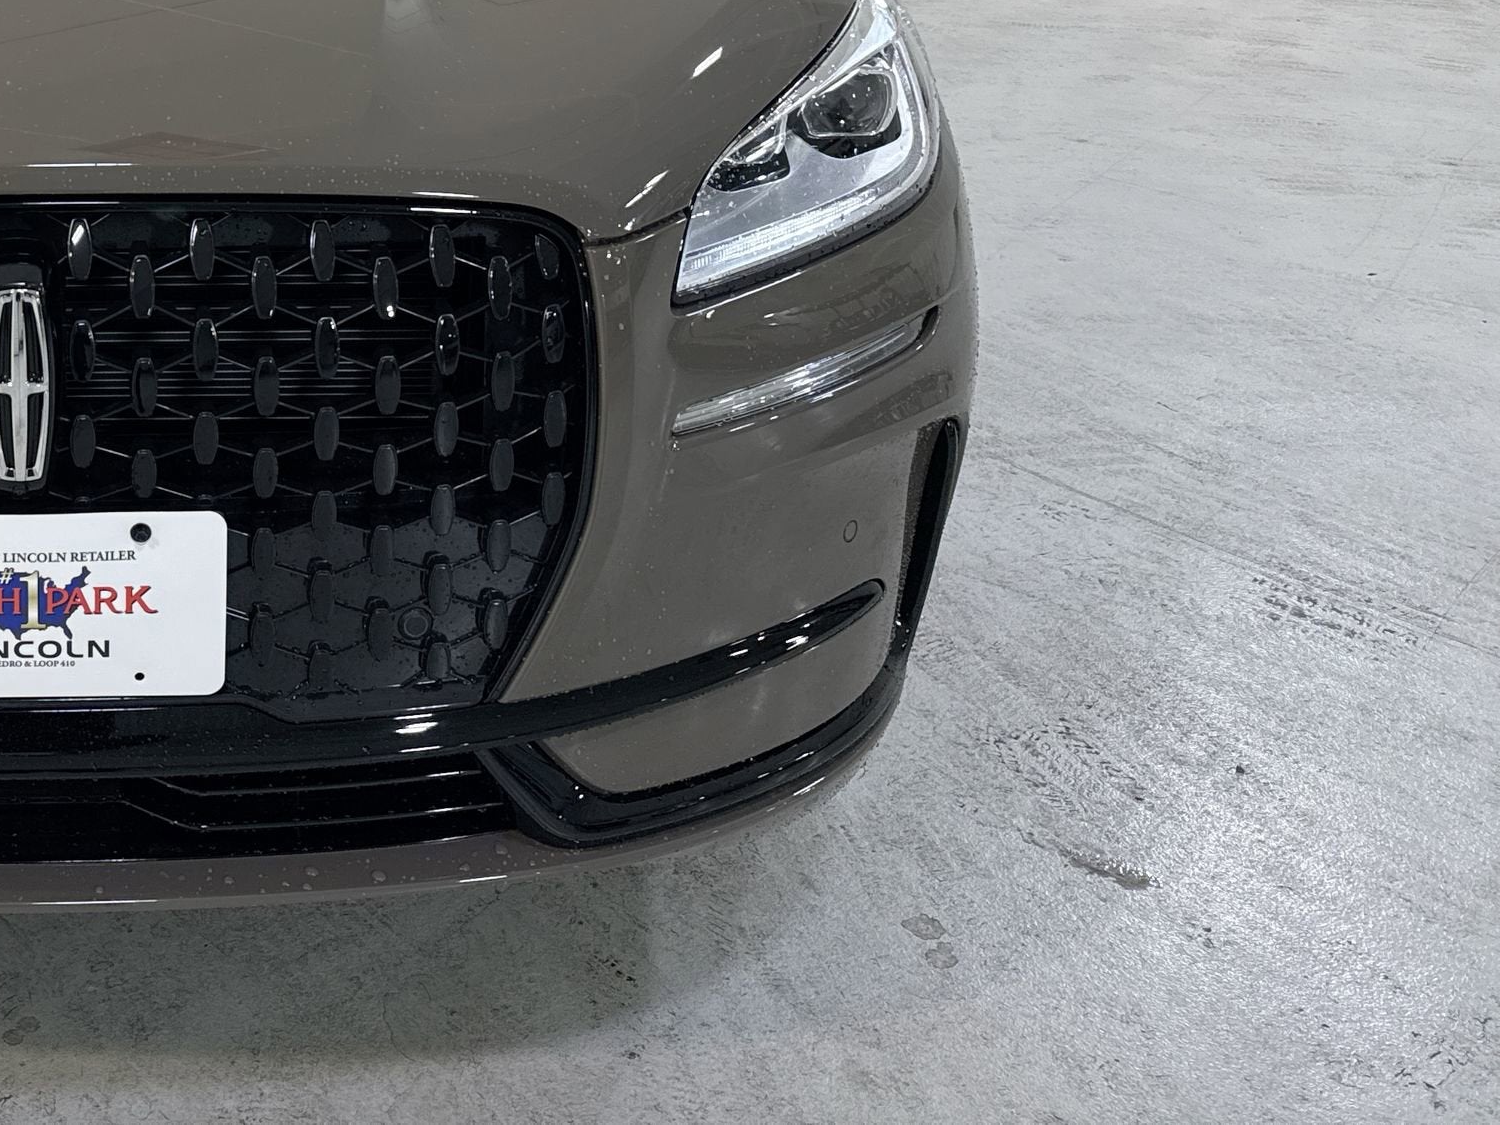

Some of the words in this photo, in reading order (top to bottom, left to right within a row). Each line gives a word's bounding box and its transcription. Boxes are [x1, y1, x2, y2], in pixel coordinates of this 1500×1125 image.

[3, 552, 67, 564] LINCOLN
[70, 550, 137, 563] RETAILER
[45, 585, 159, 615] PARK
